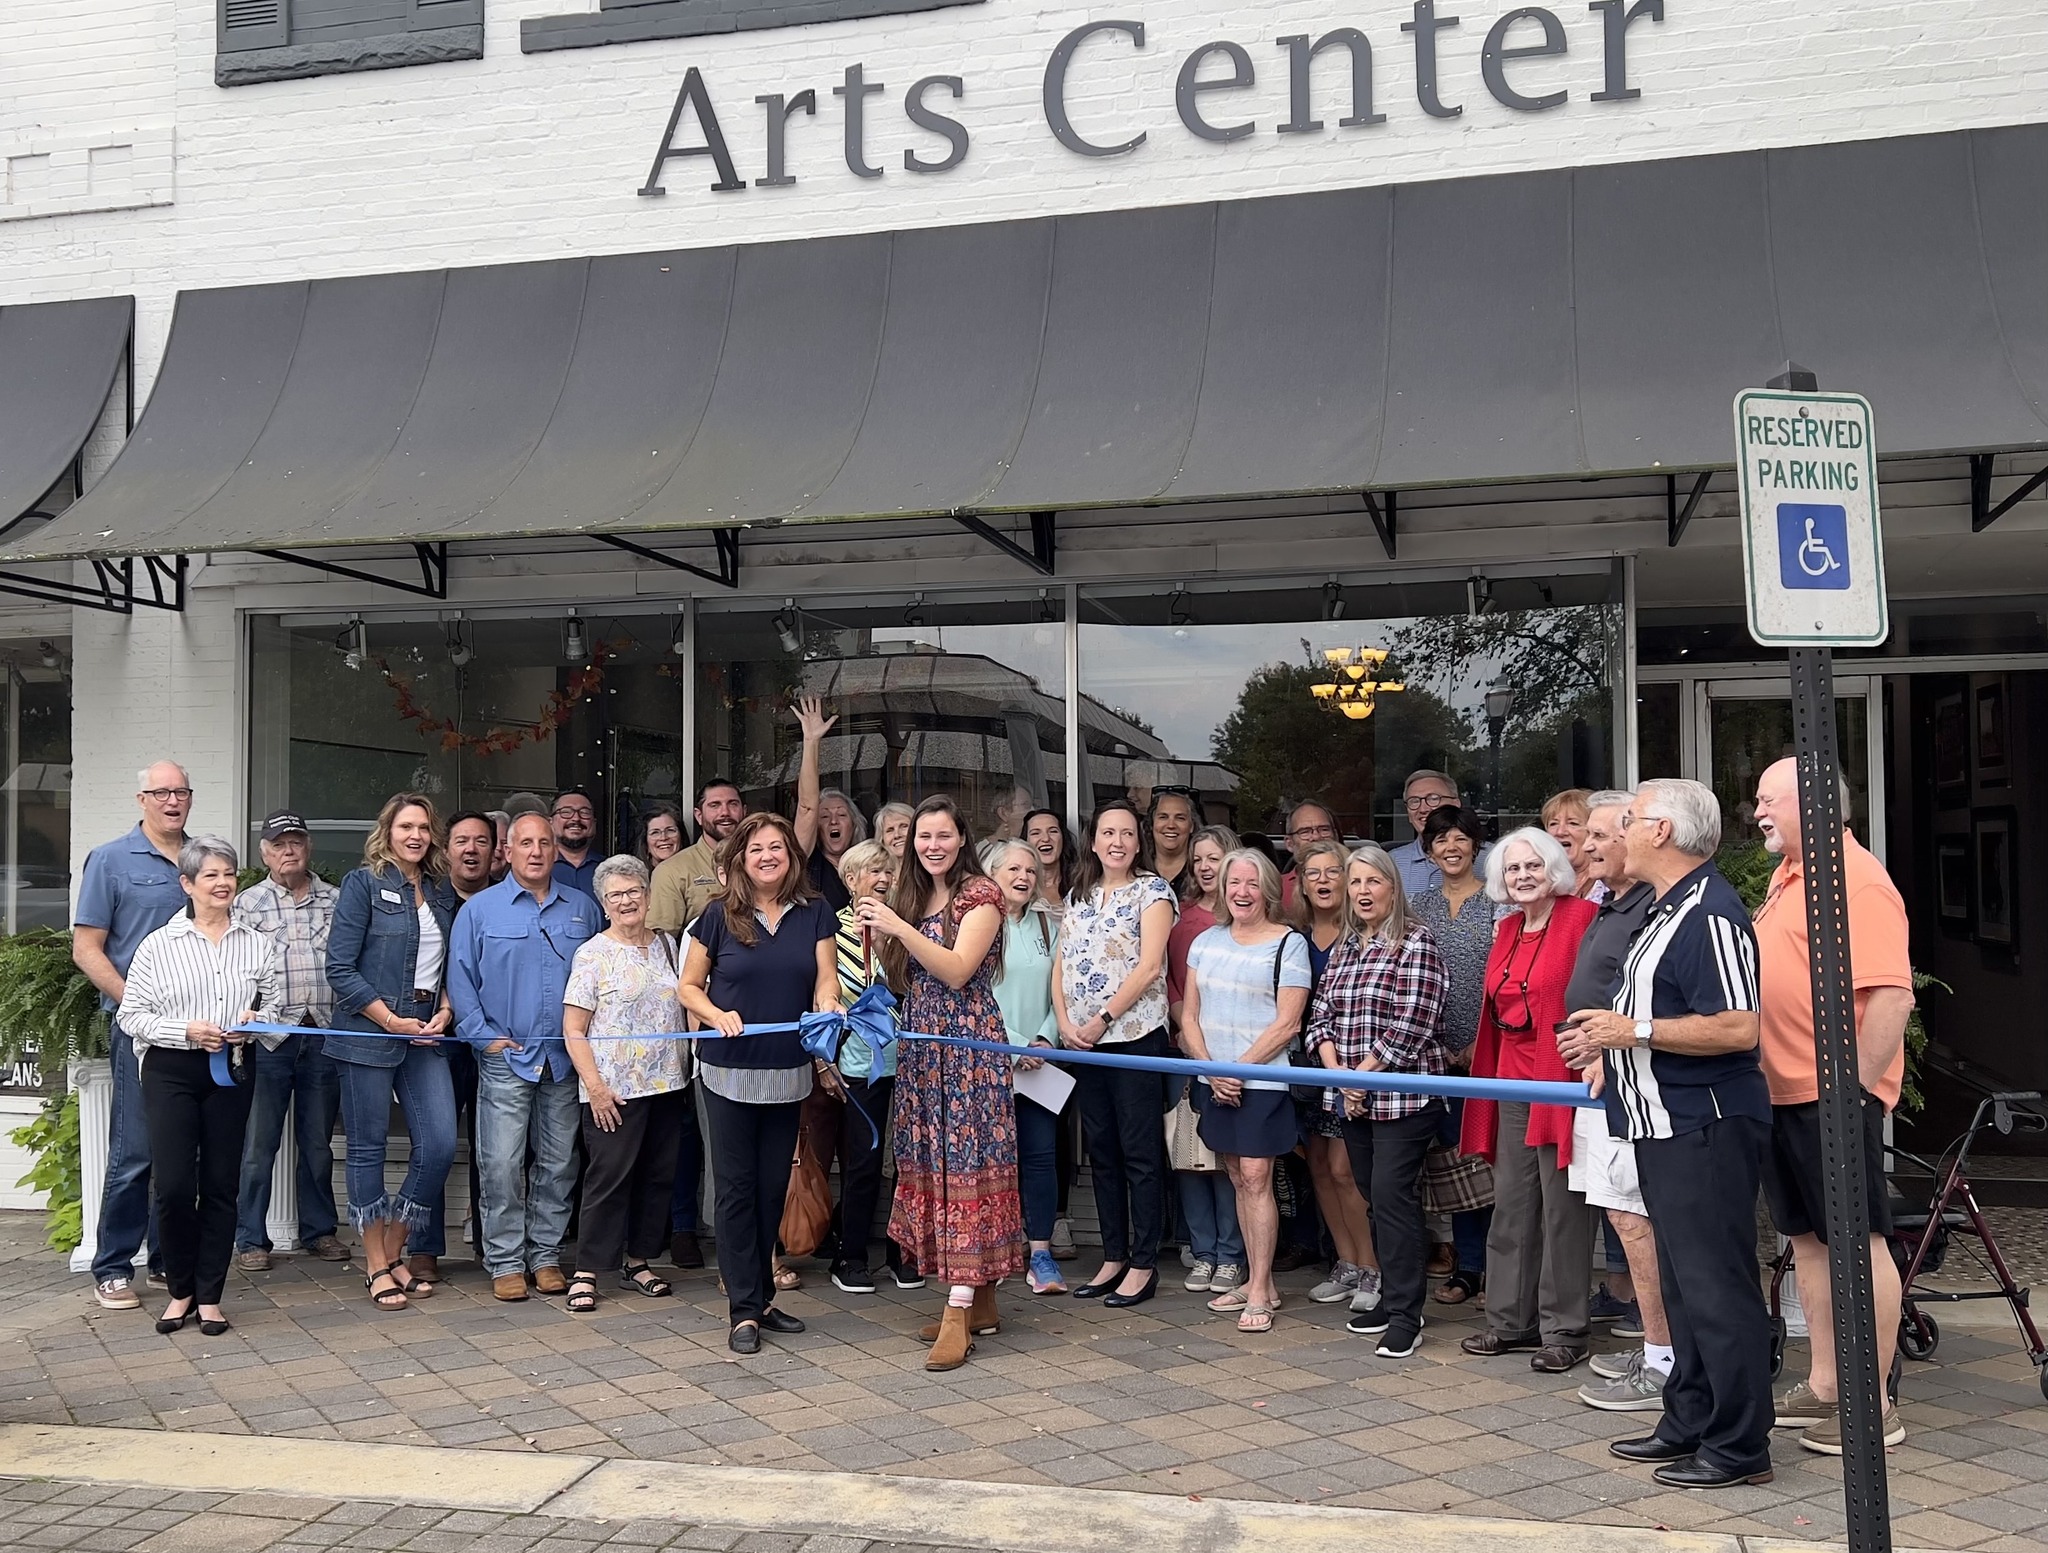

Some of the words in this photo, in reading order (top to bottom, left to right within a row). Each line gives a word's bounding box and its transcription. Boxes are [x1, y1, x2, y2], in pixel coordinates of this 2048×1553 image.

[637, 62, 970, 198] Arts
[1042, 0, 1665, 157] Center
[1749, 416, 1862, 448] RESERVED
[1758, 459, 1858, 491] PARKING
